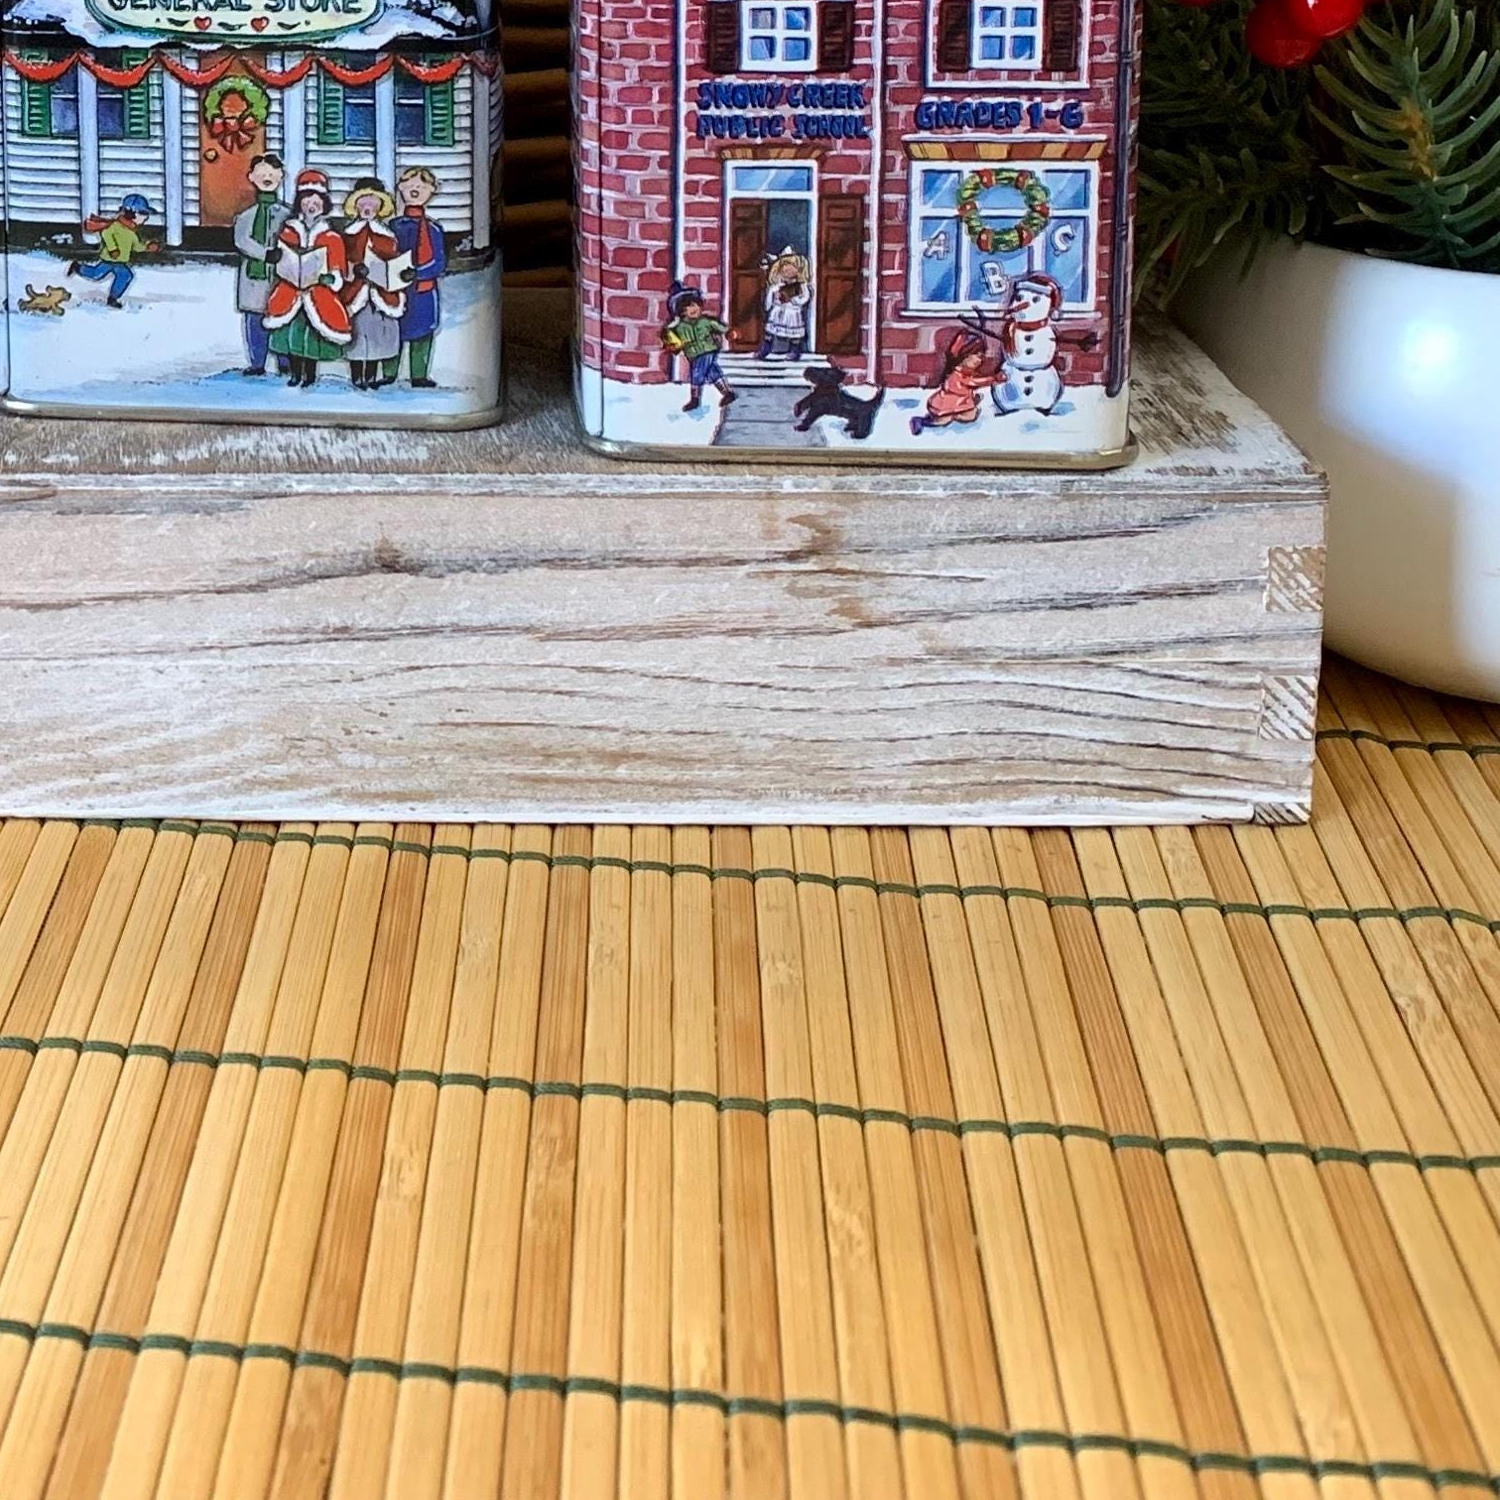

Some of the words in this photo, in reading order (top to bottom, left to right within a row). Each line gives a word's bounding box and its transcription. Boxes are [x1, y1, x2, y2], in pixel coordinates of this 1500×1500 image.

[698, 82, 784, 111] SNOWY
[787, 83, 867, 109] CREEK
[697, 114, 784, 139] PUBLIC
[792, 114, 870, 139] SCHOOL
[914, 101, 1022, 130] GRADES
[1026, 102, 1084, 130] 1-6
